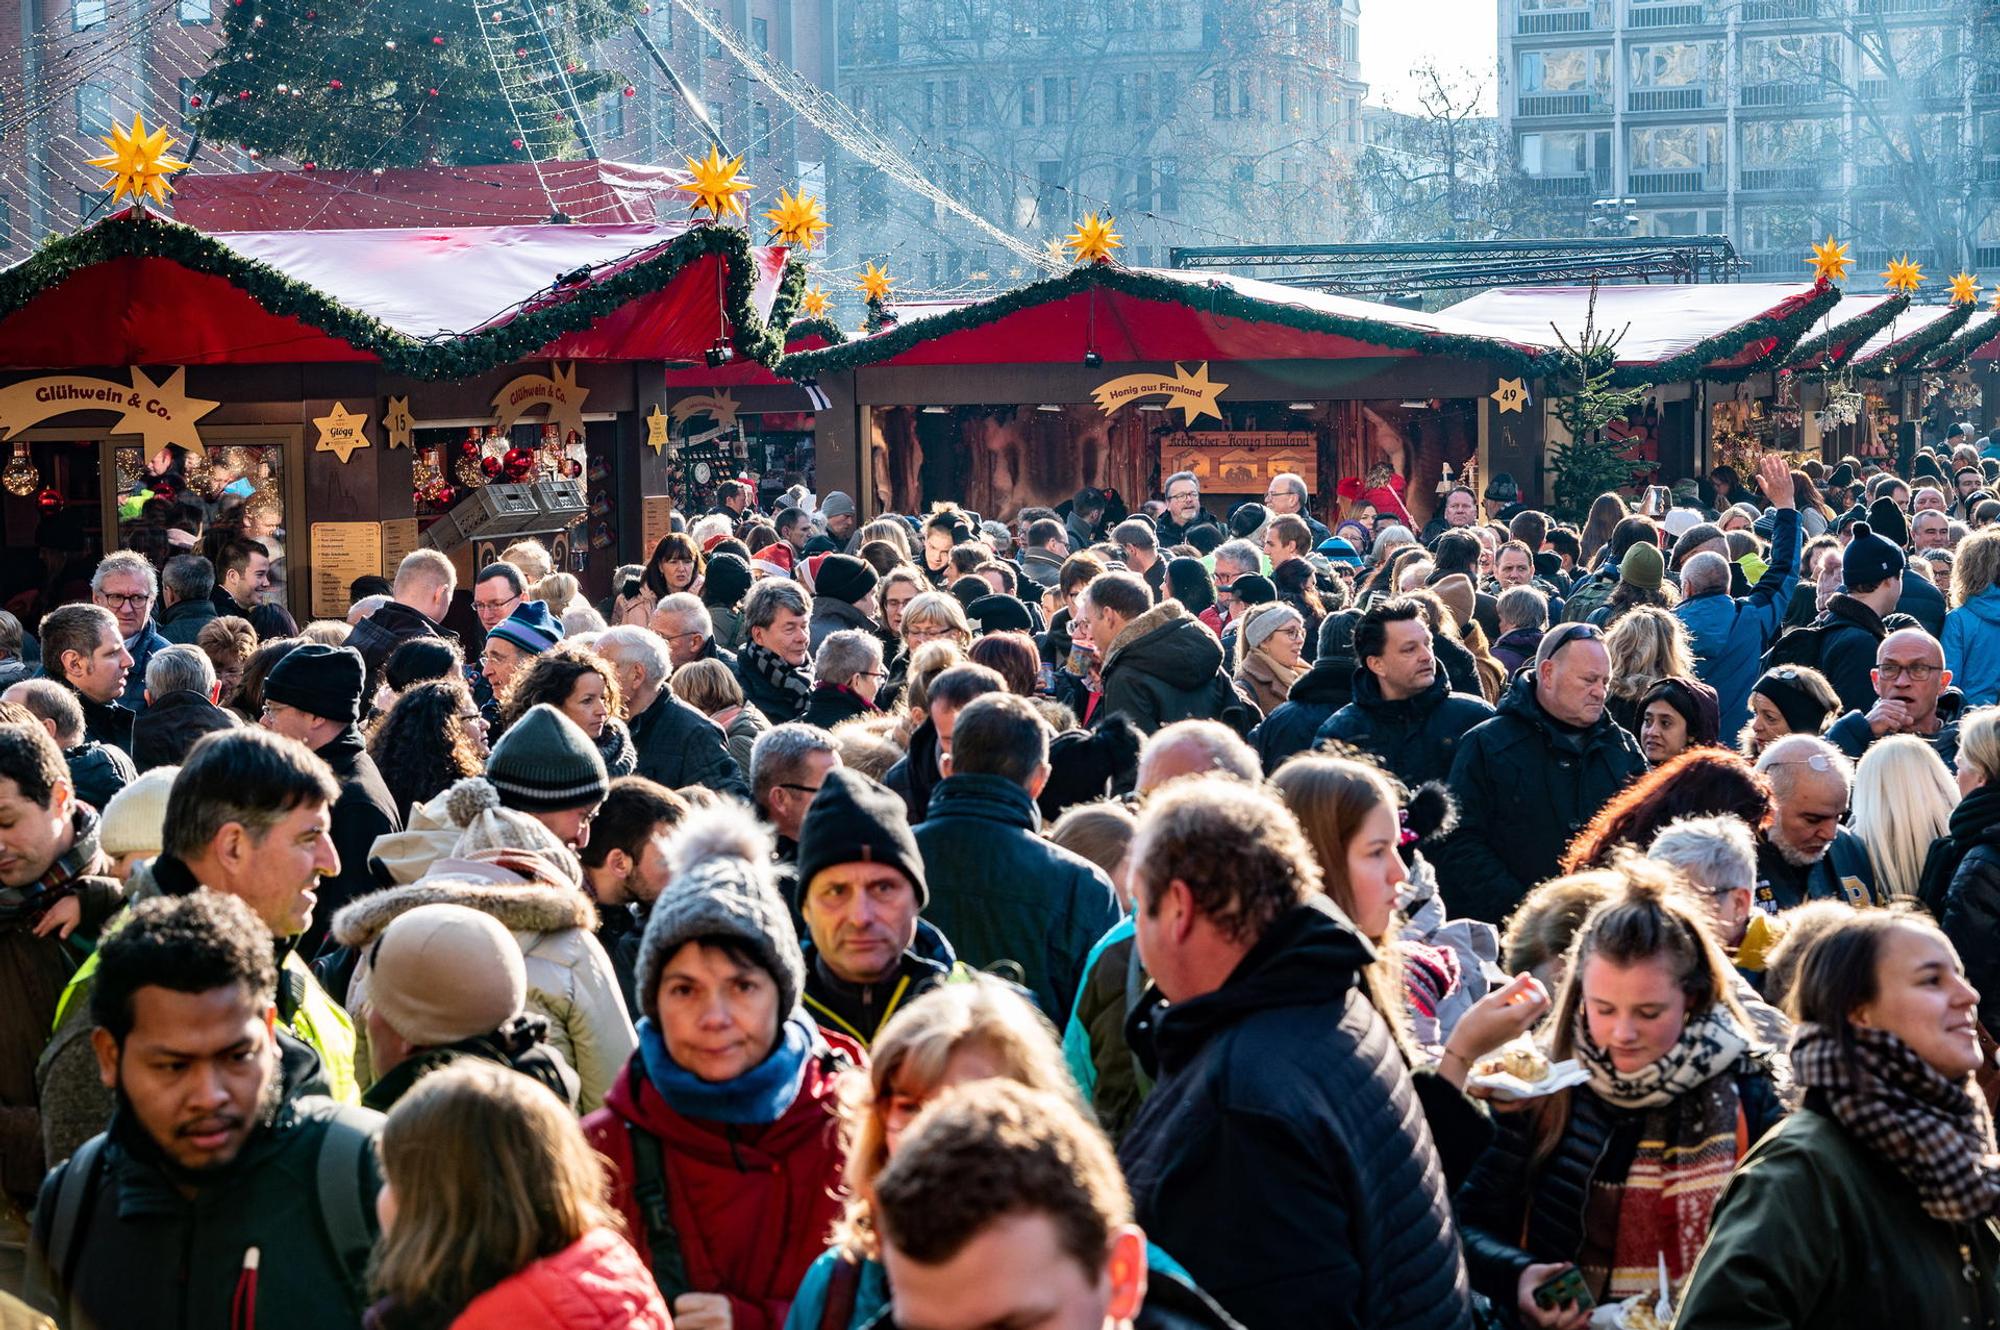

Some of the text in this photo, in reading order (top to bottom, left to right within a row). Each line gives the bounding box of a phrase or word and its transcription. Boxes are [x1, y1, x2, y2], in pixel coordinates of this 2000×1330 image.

[510, 384, 546, 406] Glühwein
[1109, 382, 1203, 399] Honig aus Finnland
[1502, 389, 1517, 402] 49
[35, 385, 171, 420] Glühwein & Co.
[395, 414, 406, 431] 15
[1264, 431, 1310, 447] Finnland
